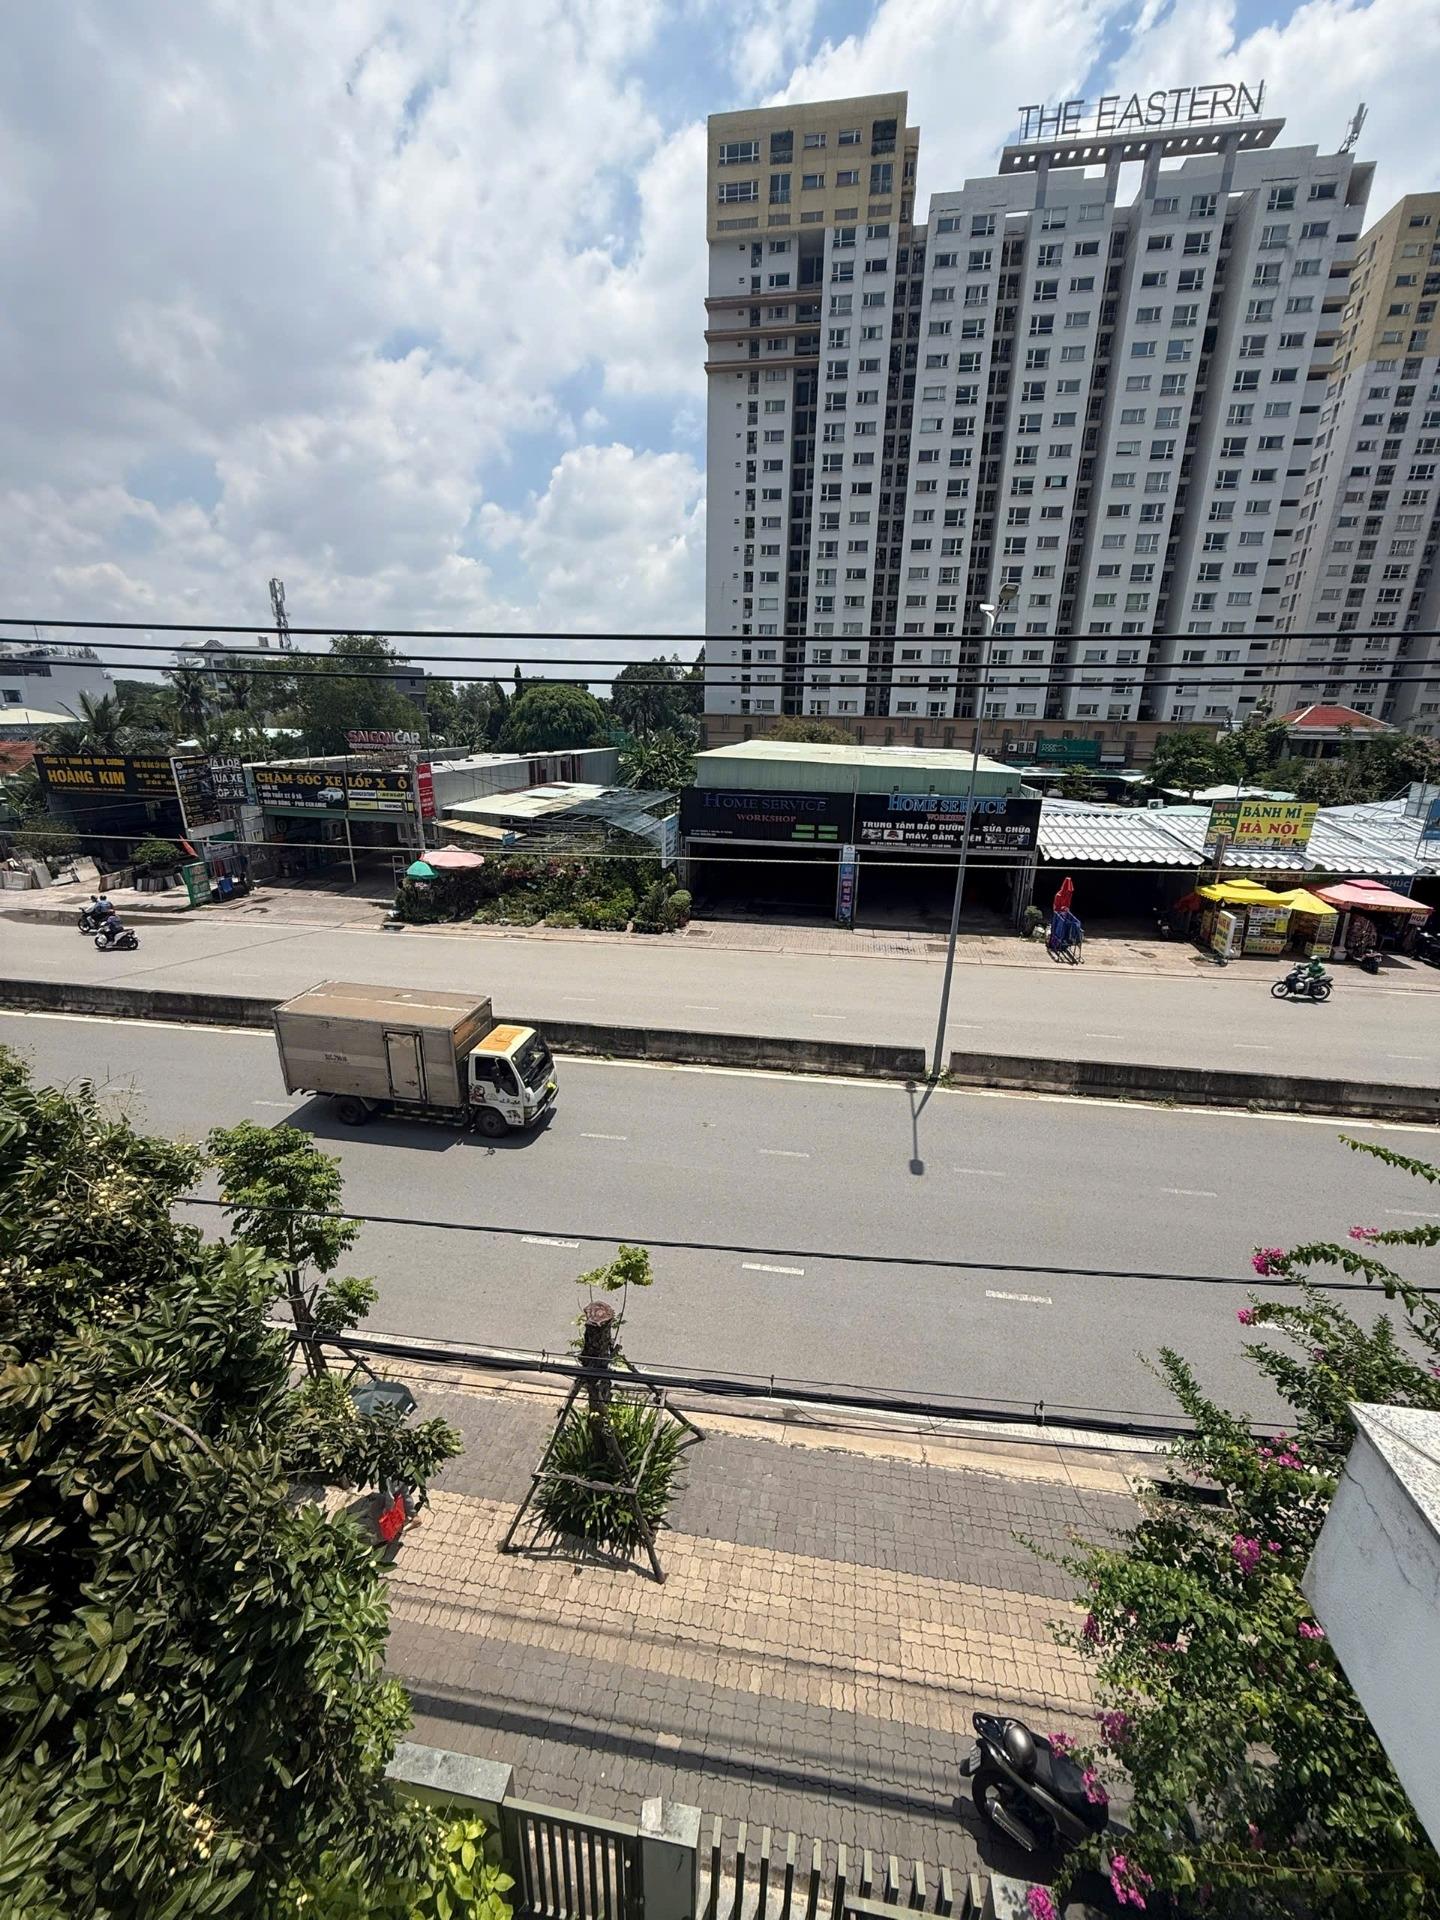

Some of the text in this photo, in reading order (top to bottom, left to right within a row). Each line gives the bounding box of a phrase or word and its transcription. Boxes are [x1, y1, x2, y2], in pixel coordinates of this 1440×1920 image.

[1018, 79, 1264, 139] THE EASTERN
[47, 766, 126, 785] HOÀNG KIM
[230, 774, 243, 783] XE
[255, 770, 343, 787] CHĂM SÓC XE
[348, 773, 373, 788] LỐP
[232, 788, 245, 797] XE
[703, 792, 826, 812] HOME SERVICE
[888, 795, 1008, 814] HOME SERVICE
[736, 813, 797, 823] WORKSHOP
[926, 813, 967, 822] WORKSHO
[1242, 804, 1282, 818] BÁNH
[1285, 805, 1303, 818] MÌ
[862, 821, 892, 829] TRUNG
[939, 823, 965, 832] DƯỠN
[1239, 820, 1299, 837] HÀ NỘI
